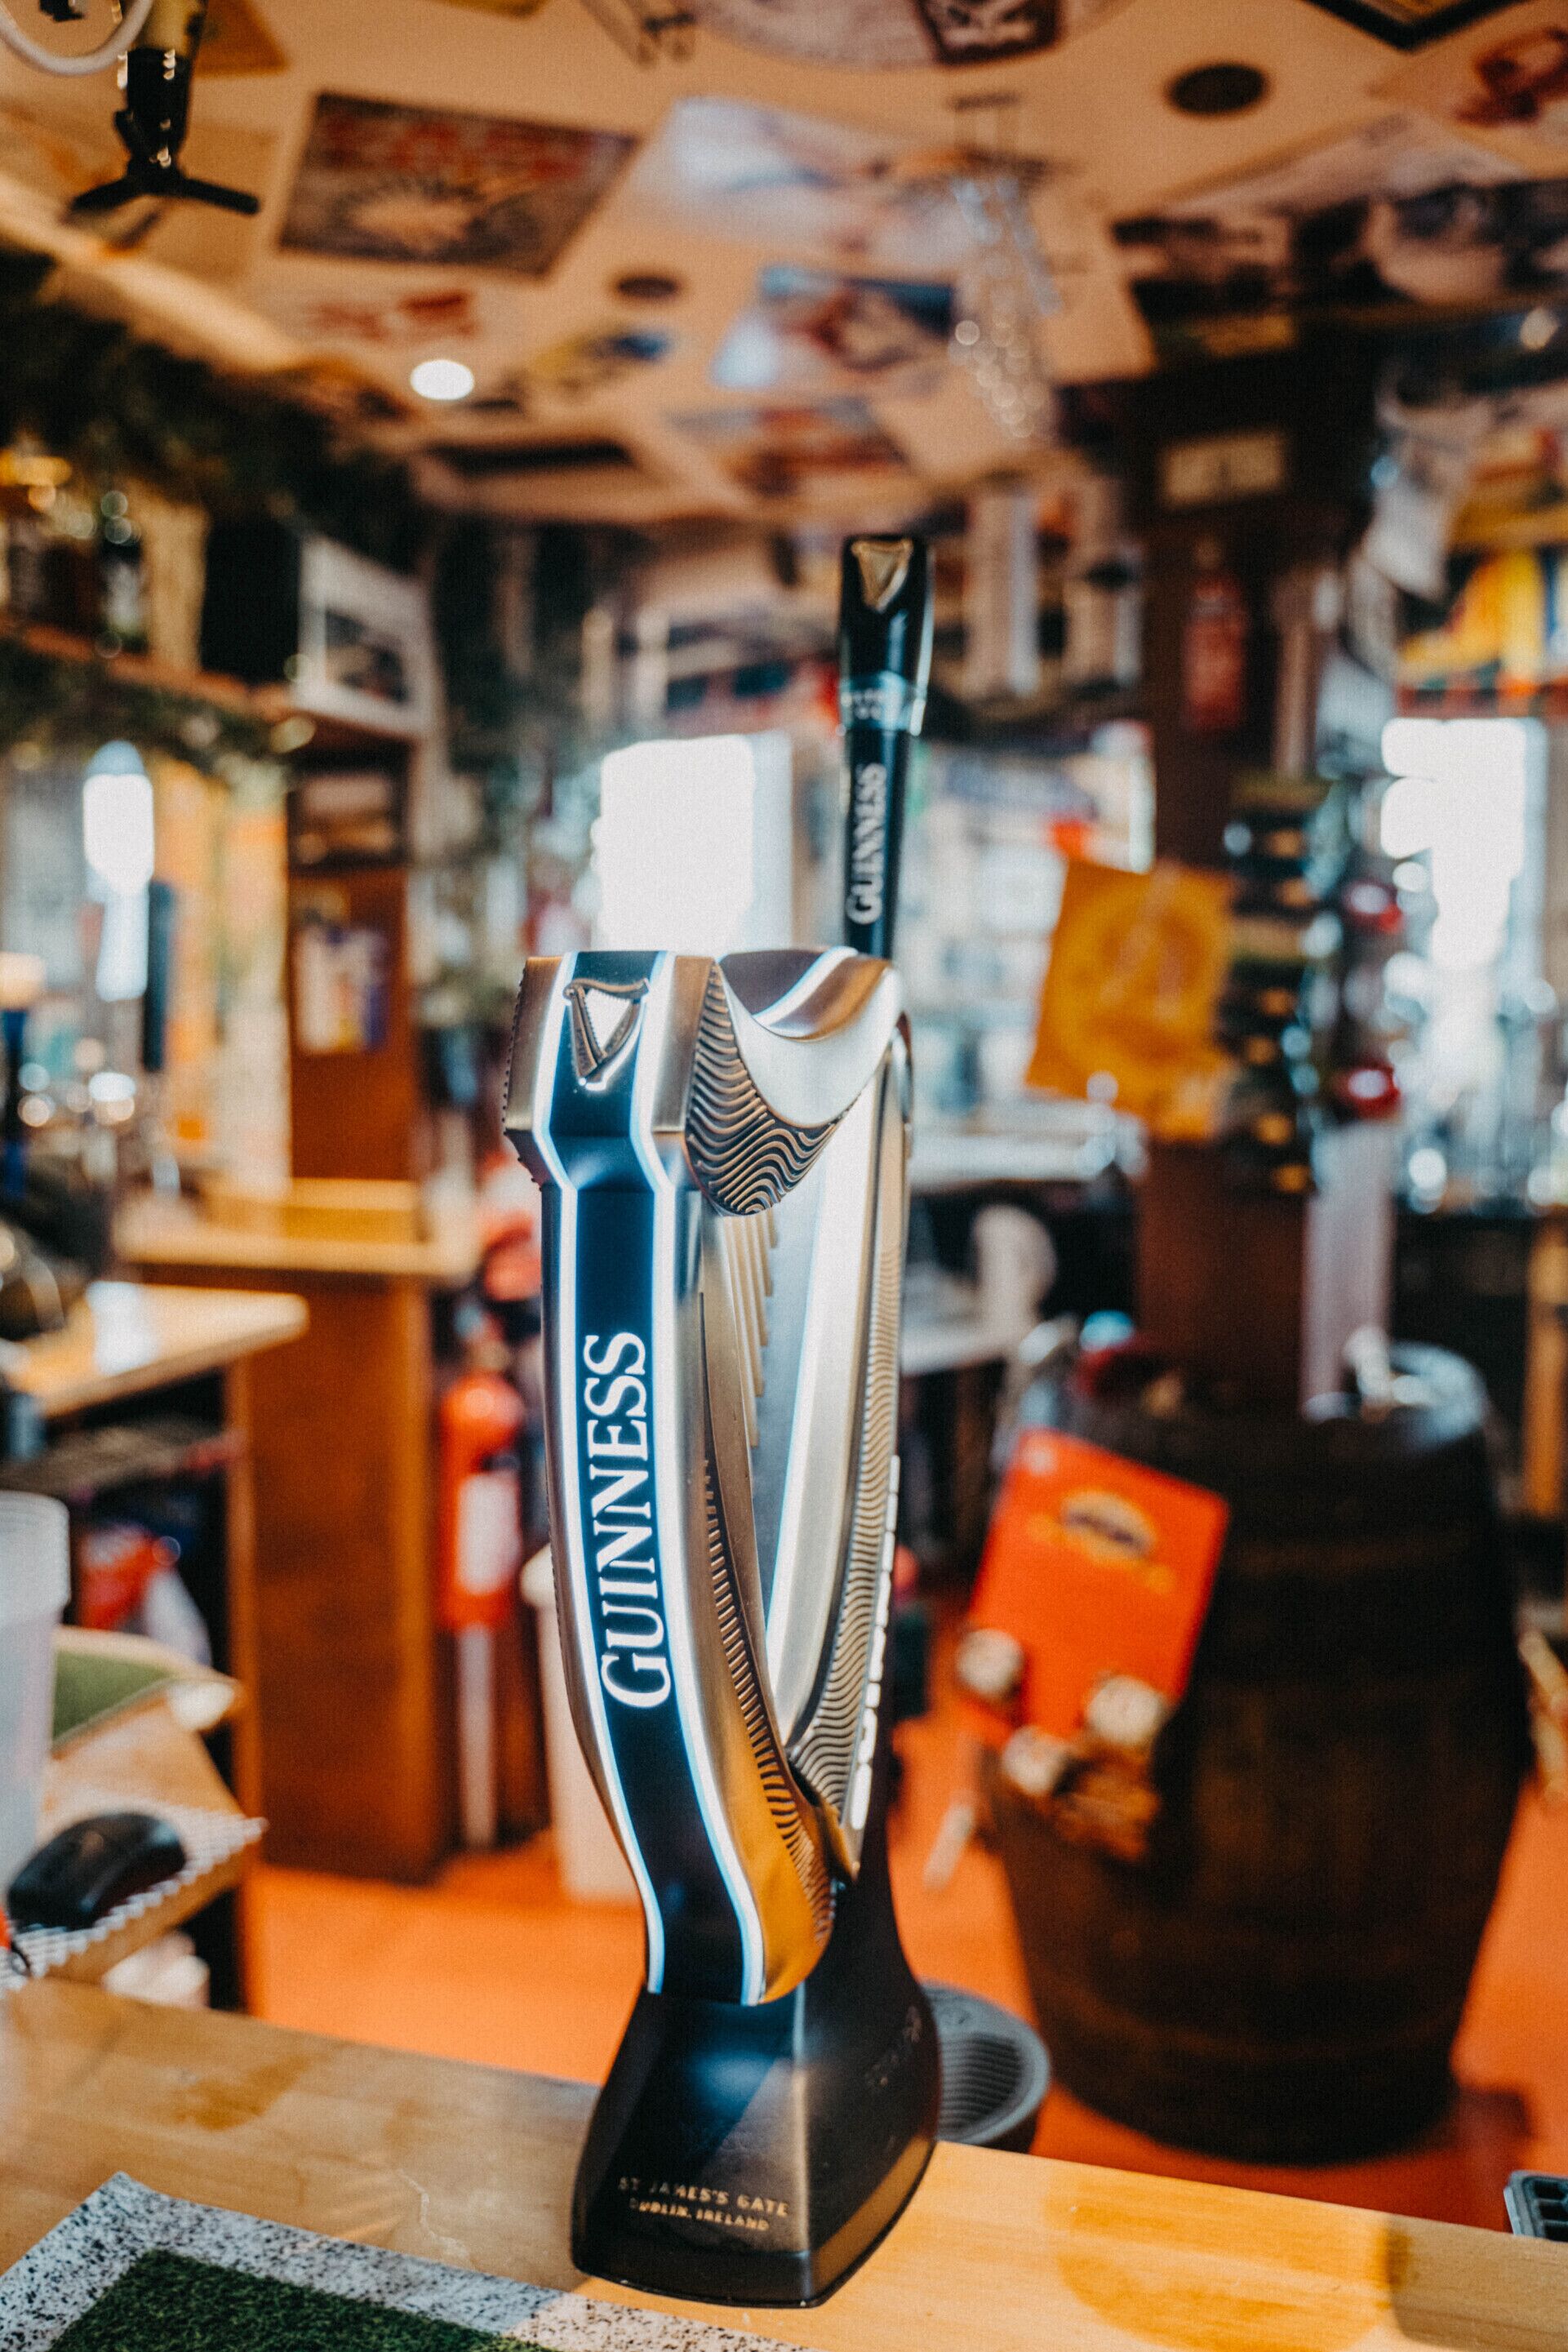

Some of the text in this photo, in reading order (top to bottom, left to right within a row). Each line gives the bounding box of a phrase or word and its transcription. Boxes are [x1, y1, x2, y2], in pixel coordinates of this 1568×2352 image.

[845, 763, 886, 925] GUINNESS
[584, 1332, 672, 1708] GUINNESS
[650, 2181, 730, 2204] JAMES'S
[737, 2194, 789, 2218] GATE
[695, 2208, 770, 2231] IRELAND
